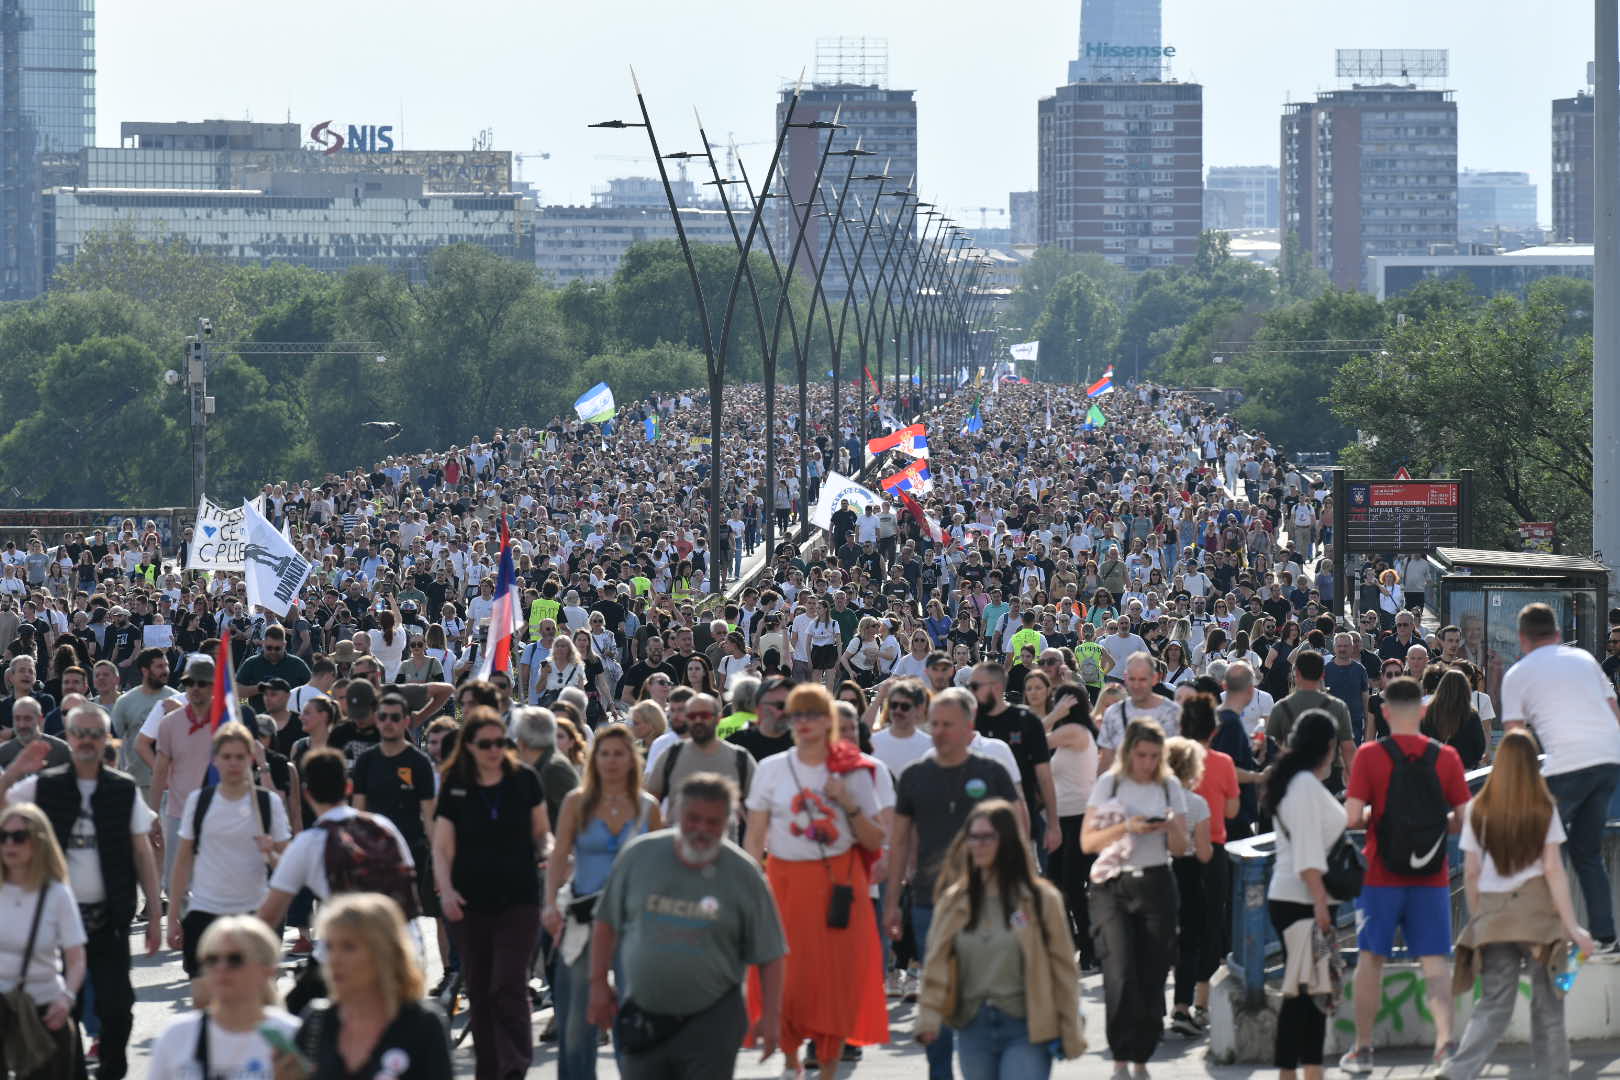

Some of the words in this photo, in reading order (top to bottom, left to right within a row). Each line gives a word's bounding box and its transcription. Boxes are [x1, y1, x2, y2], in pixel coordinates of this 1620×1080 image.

[1086, 42, 1176, 57] Hisense
[348, 124, 394, 152] NIS
[199, 543, 245, 564] СРЦЕ
